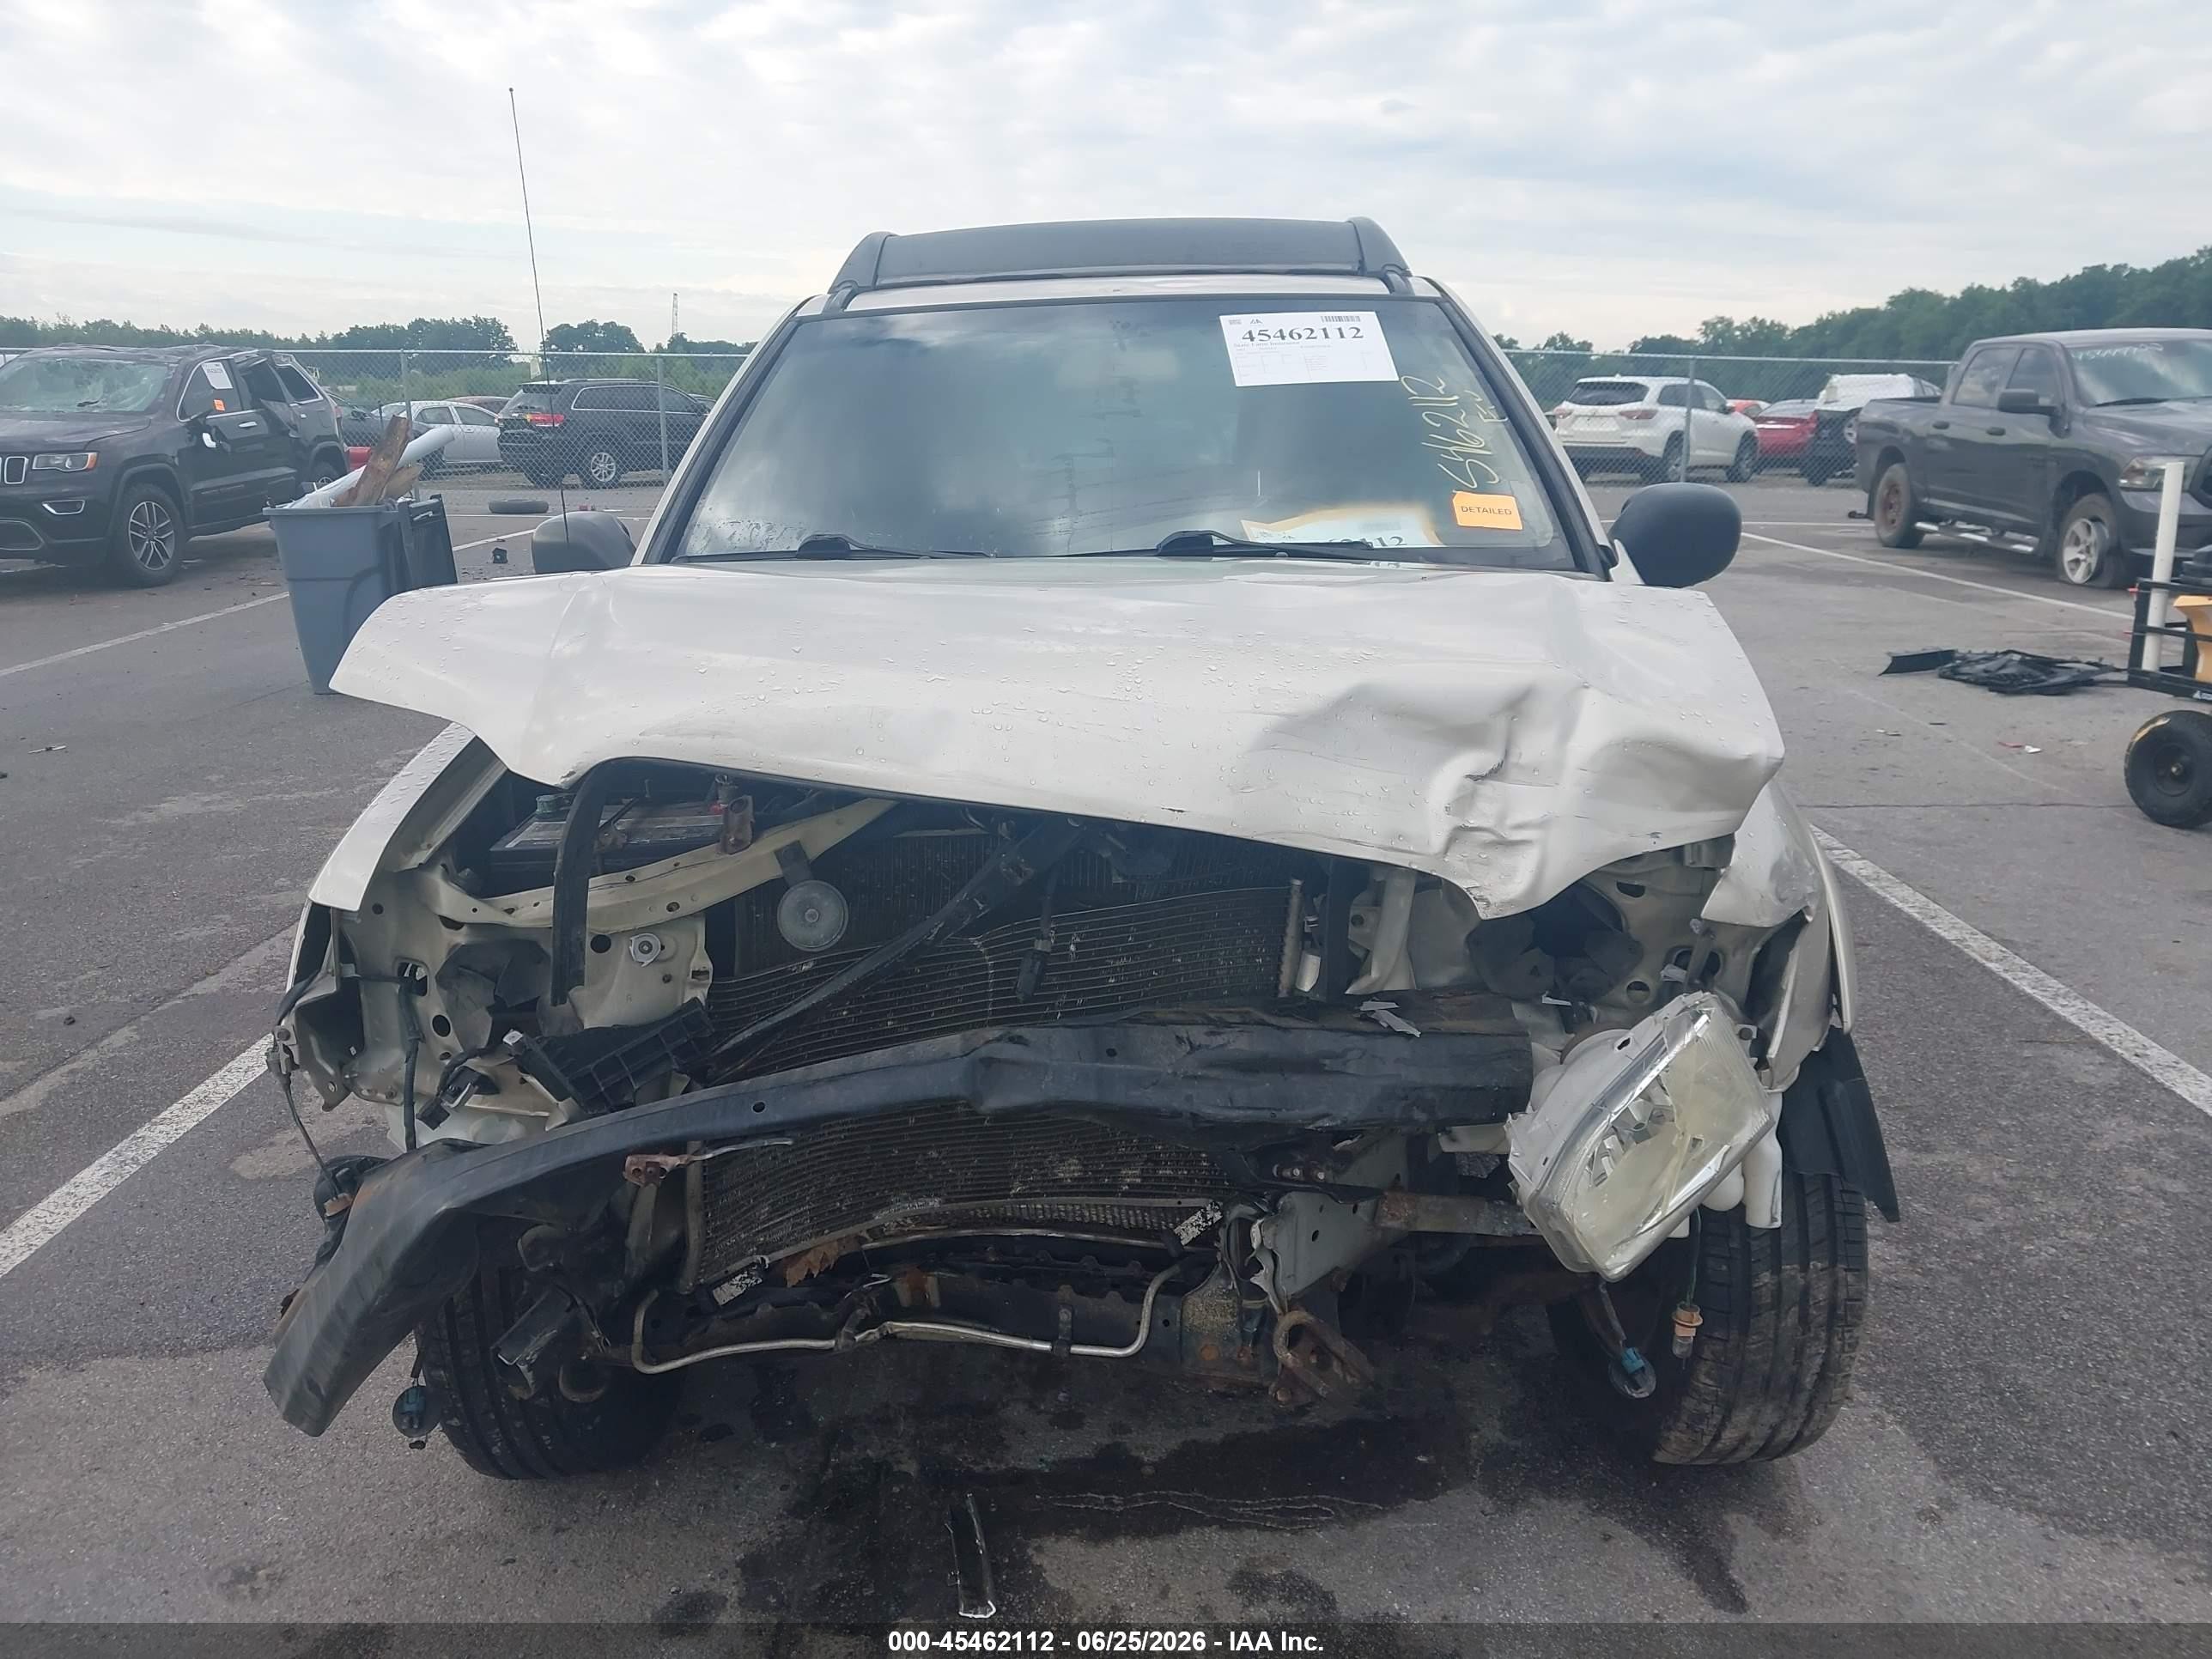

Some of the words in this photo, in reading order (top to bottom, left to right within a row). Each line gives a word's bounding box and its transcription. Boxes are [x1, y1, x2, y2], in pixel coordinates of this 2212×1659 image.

[1242, 326, 1364, 342] 45462112
[1401, 375, 1499, 491] 5462112
[1461, 505, 1512, 515] DETAILED
